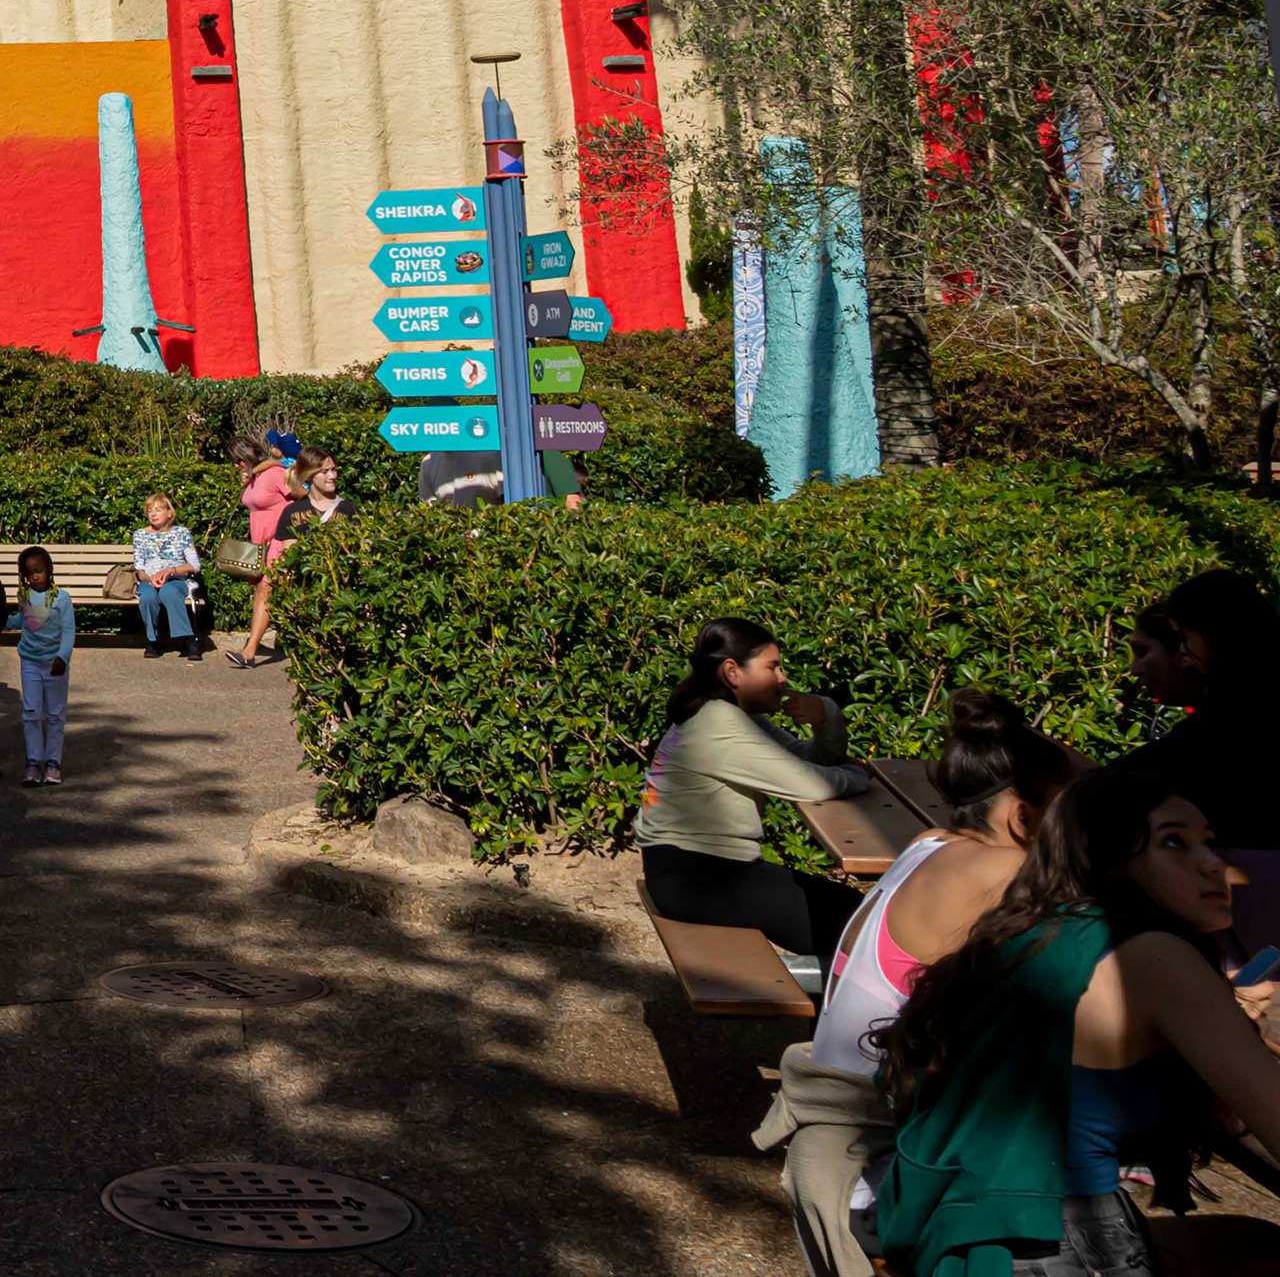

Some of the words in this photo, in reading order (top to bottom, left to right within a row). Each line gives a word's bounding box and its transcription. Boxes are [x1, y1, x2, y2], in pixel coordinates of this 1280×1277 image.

[375, 204, 447, 219] SHEIKRA
[388, 245, 446, 258] CONGO
[543, 242, 562, 255] IRON
[395, 258, 441, 271] RIVER
[540, 255, 566, 269] GWAZI
[391, 270, 448, 283] RAPIDS
[387, 306, 449, 321] BUMPER
[545, 307, 561, 320] ATM
[573, 307, 596, 319] AND
[399, 319, 440, 333] CARS
[571, 320, 604, 333] RPENT
[392, 367, 448, 381] TIGRIS
[389, 423, 422, 436] SKY
[424, 422, 460, 435] RIDE
[555, 421, 605, 435] RESTROOMS
